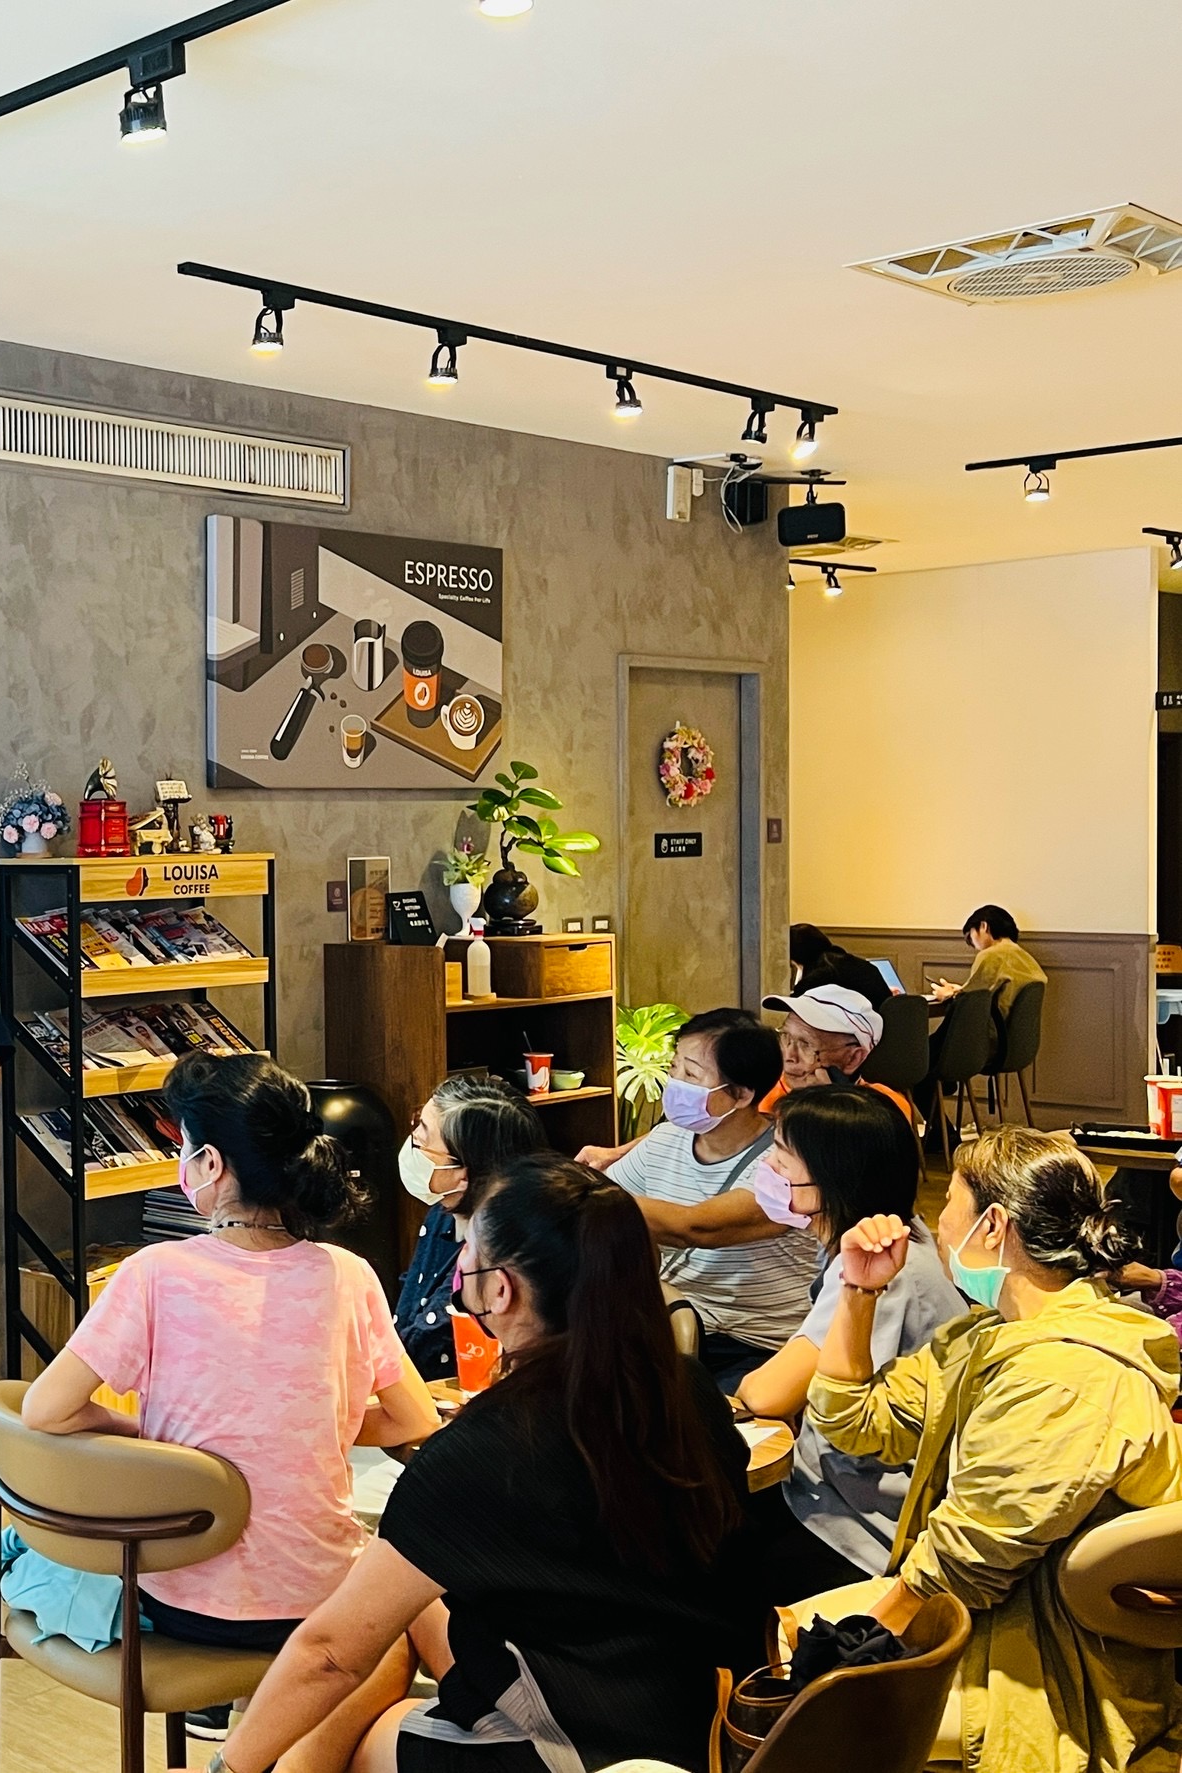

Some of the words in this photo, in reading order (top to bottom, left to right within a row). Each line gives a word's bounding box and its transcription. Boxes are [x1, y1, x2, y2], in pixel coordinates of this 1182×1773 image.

[404, 560, 493, 592] ESPRESSO
[459, 595, 474, 603] Coffee
[163, 864, 219, 881] LOUISA
[173, 884, 211, 895] COFFEE
